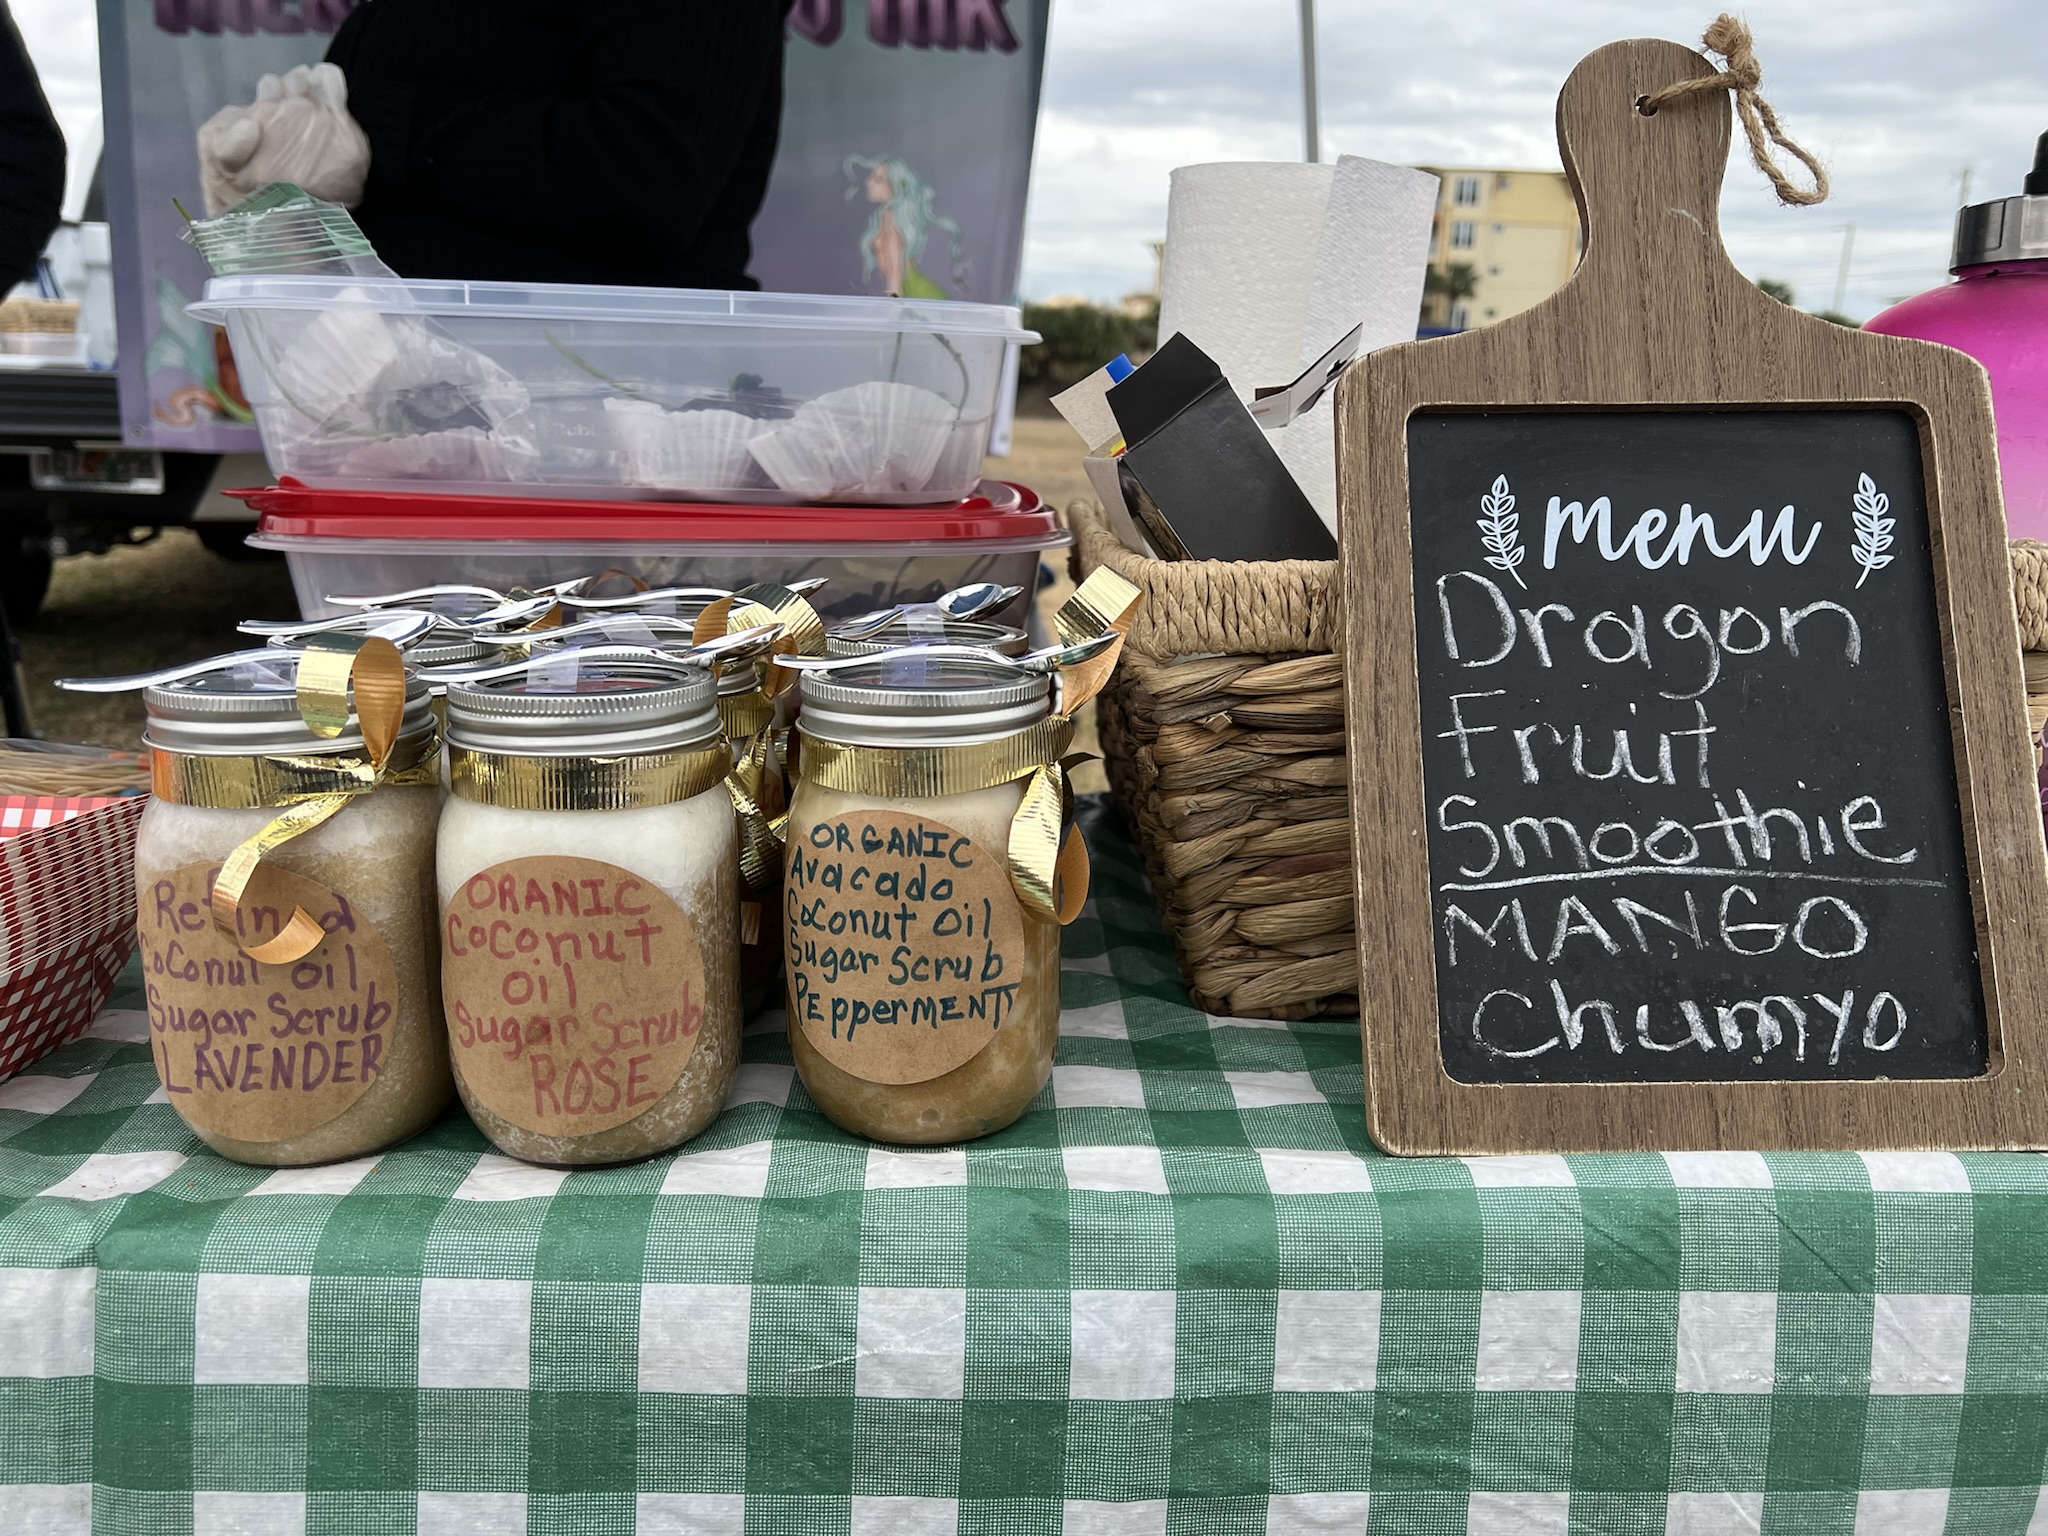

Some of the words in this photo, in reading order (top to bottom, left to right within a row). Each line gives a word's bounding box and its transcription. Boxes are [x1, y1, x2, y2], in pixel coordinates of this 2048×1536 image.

[1543, 495, 1822, 570] menu
[1436, 571, 1862, 699] Dragon
[1438, 689, 1718, 788] Fruit
[810, 822, 973, 868] ORGANIC
[1437, 783, 1918, 878] Smoothie
[154, 867, 356, 938] Refind
[466, 873, 652, 918] ORANIC
[790, 846, 953, 902] Avacado
[790, 927, 879, 984] Sugar
[888, 940, 1003, 986] Scrub
[1444, 884, 1868, 966] MANGO
[148, 983, 256, 1050] Sugar
[267, 981, 392, 1039] Scrub
[455, 1000, 580, 1061] Sugar
[591, 980, 702, 1056] Scrub
[161, 1033, 382, 1094] LAVENDER
[530, 1053, 659, 1118] ROSE
